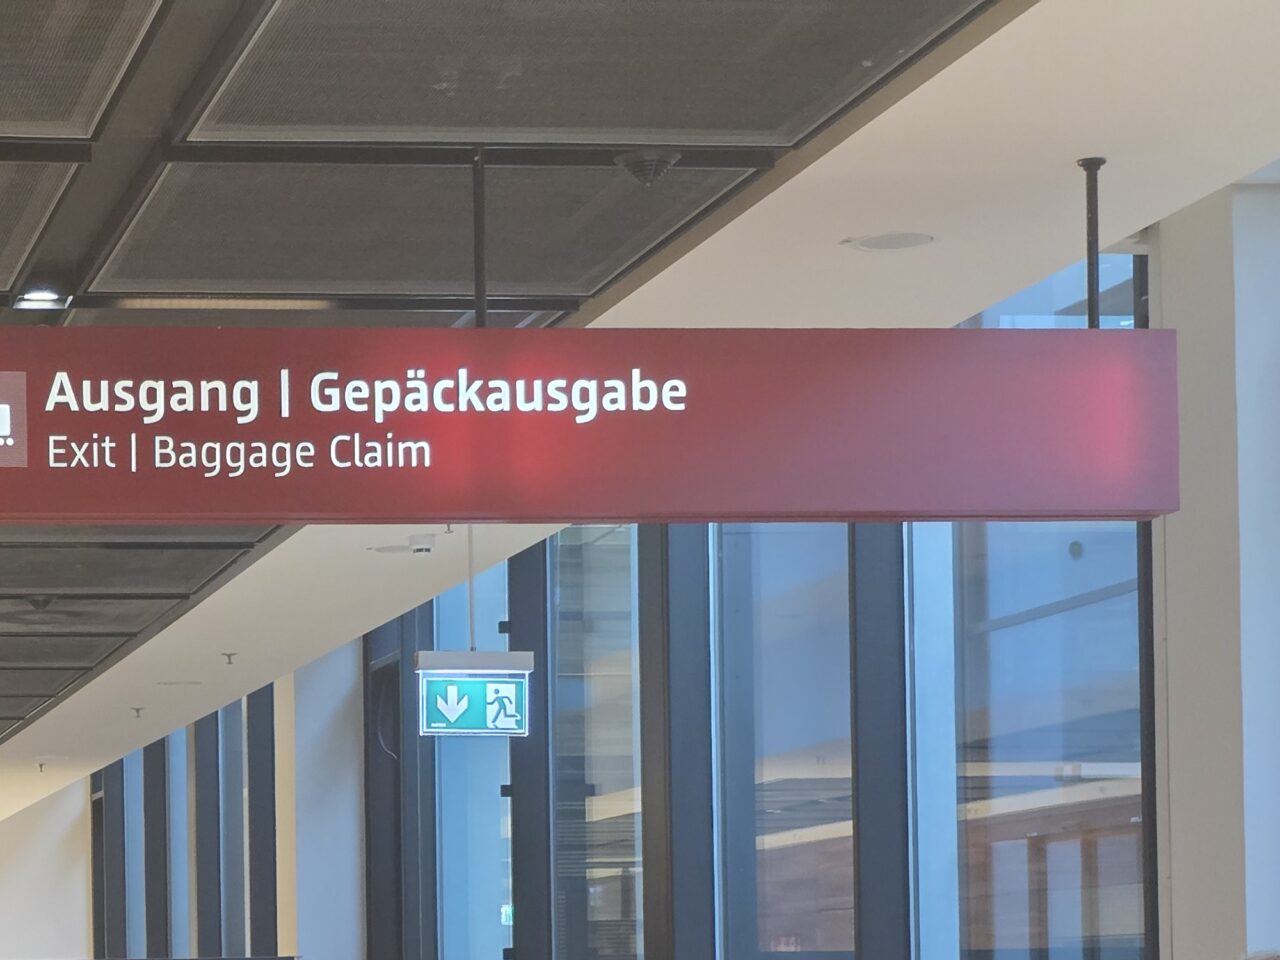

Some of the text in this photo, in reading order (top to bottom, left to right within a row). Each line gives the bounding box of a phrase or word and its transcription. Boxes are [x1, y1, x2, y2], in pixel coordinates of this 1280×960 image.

[45, 371, 259, 424] Ausgang
[310, 367, 688, 424] Gepäckausgabe
[48, 433, 116, 468] Exit
[154, 435, 315, 478] Baggage
[330, 433, 431, 468] Claim
